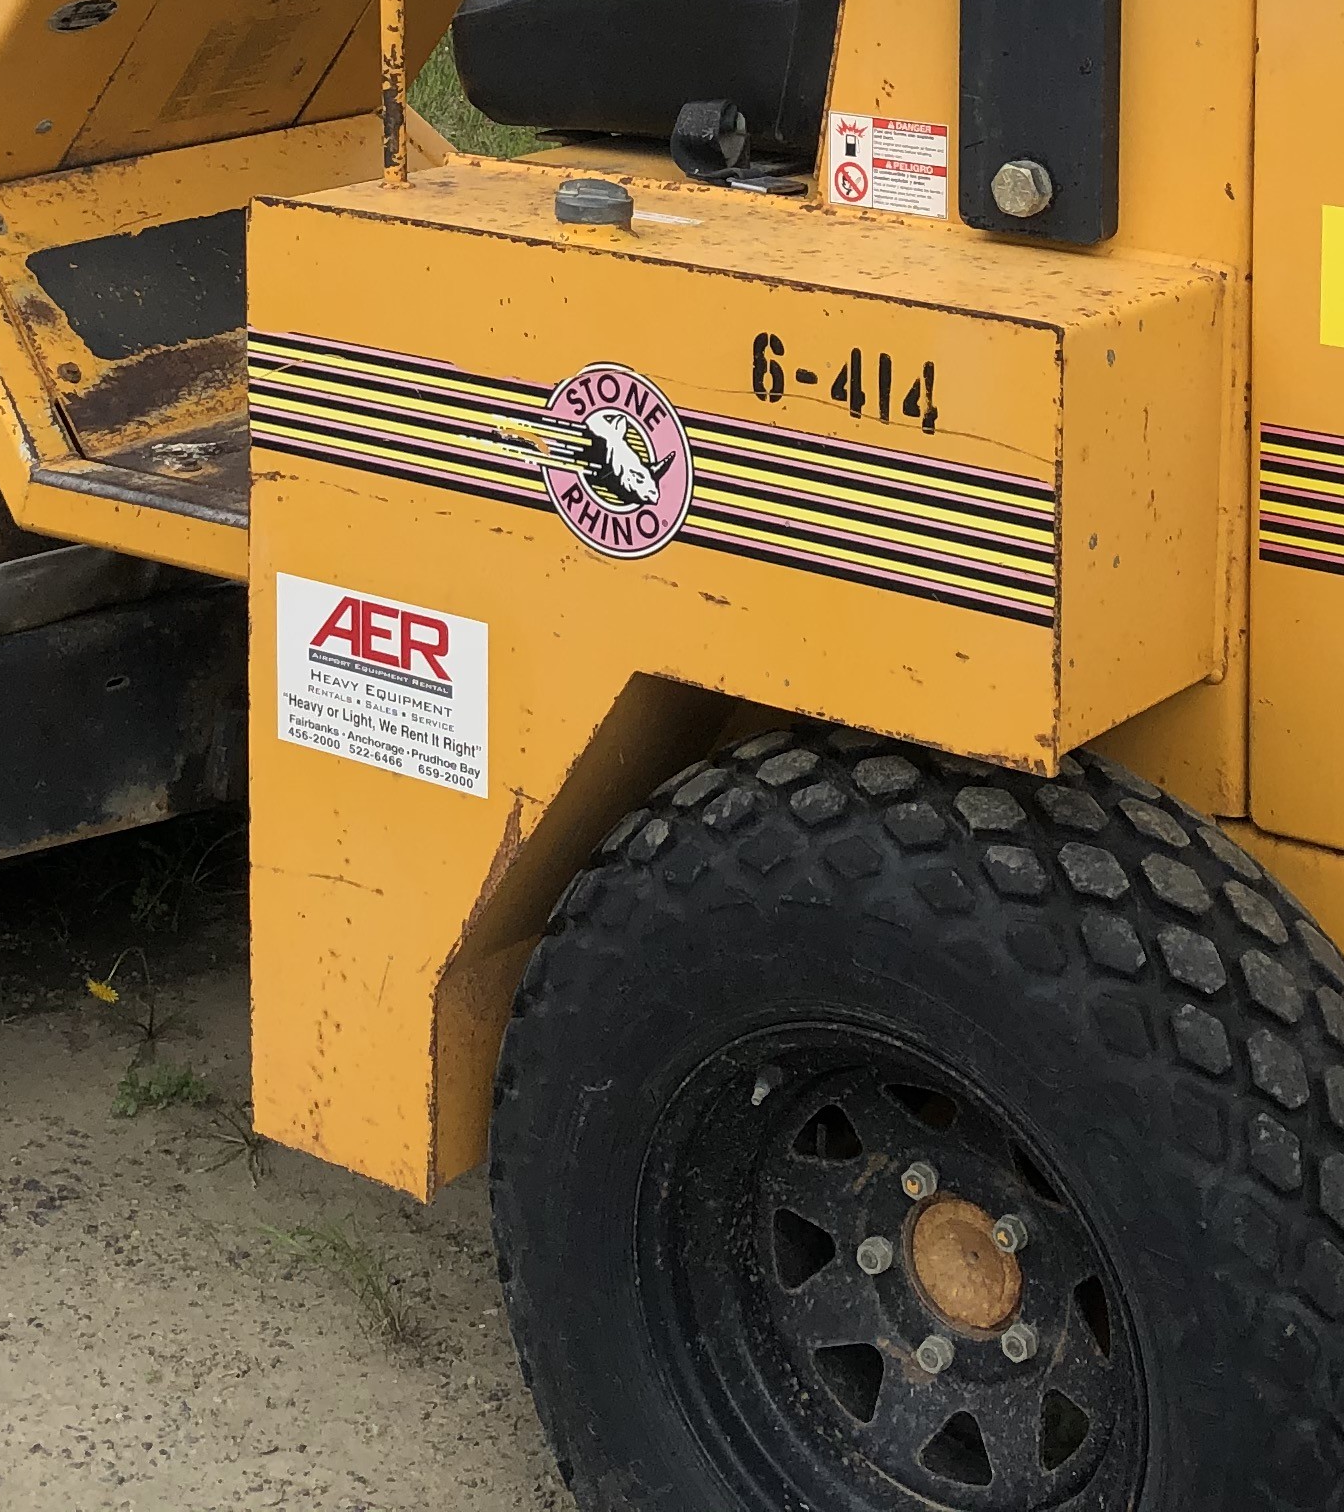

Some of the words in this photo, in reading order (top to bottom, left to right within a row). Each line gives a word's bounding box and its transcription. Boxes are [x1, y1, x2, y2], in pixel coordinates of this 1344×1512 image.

[895, 121, 932, 134] DANGER
[892, 162, 934, 175] PELIGRO
[566, 374, 667, 432] STONE
[752, 332, 939, 434] 6-414
[561, 482, 660, 545] RHINO
[310, 596, 453, 682] AER
[310, 669, 359, 692] HEAVY
[365, 684, 453, 718] EQUIPMENT
[311, 652, 351, 668] AIRPORT
[354, 663, 409, 683] EQUIPMENT
[411, 678, 449, 694] RENTAL
[308, 684, 352, 704] RENTALS
[365, 700, 398, 716] SALES
[411, 712, 455, 732] SERVICE
[327, 706, 340, 719] or
[342, 704, 376, 731] Light,
[379, 717, 397, 735] We
[401, 724, 429, 744] Rent
[432, 732, 440, 748] It
[288, 726, 341, 750] 456-2000
[348, 744, 403, 769] 522-6466
[418, 764, 474, 789] 659-2000
[289, 713, 340, 737] Fairbanks
[347, 730, 405, 756] Anchorage
[411, 748, 457, 771] Prudhoe
[459, 762, 481, 780] Bay
